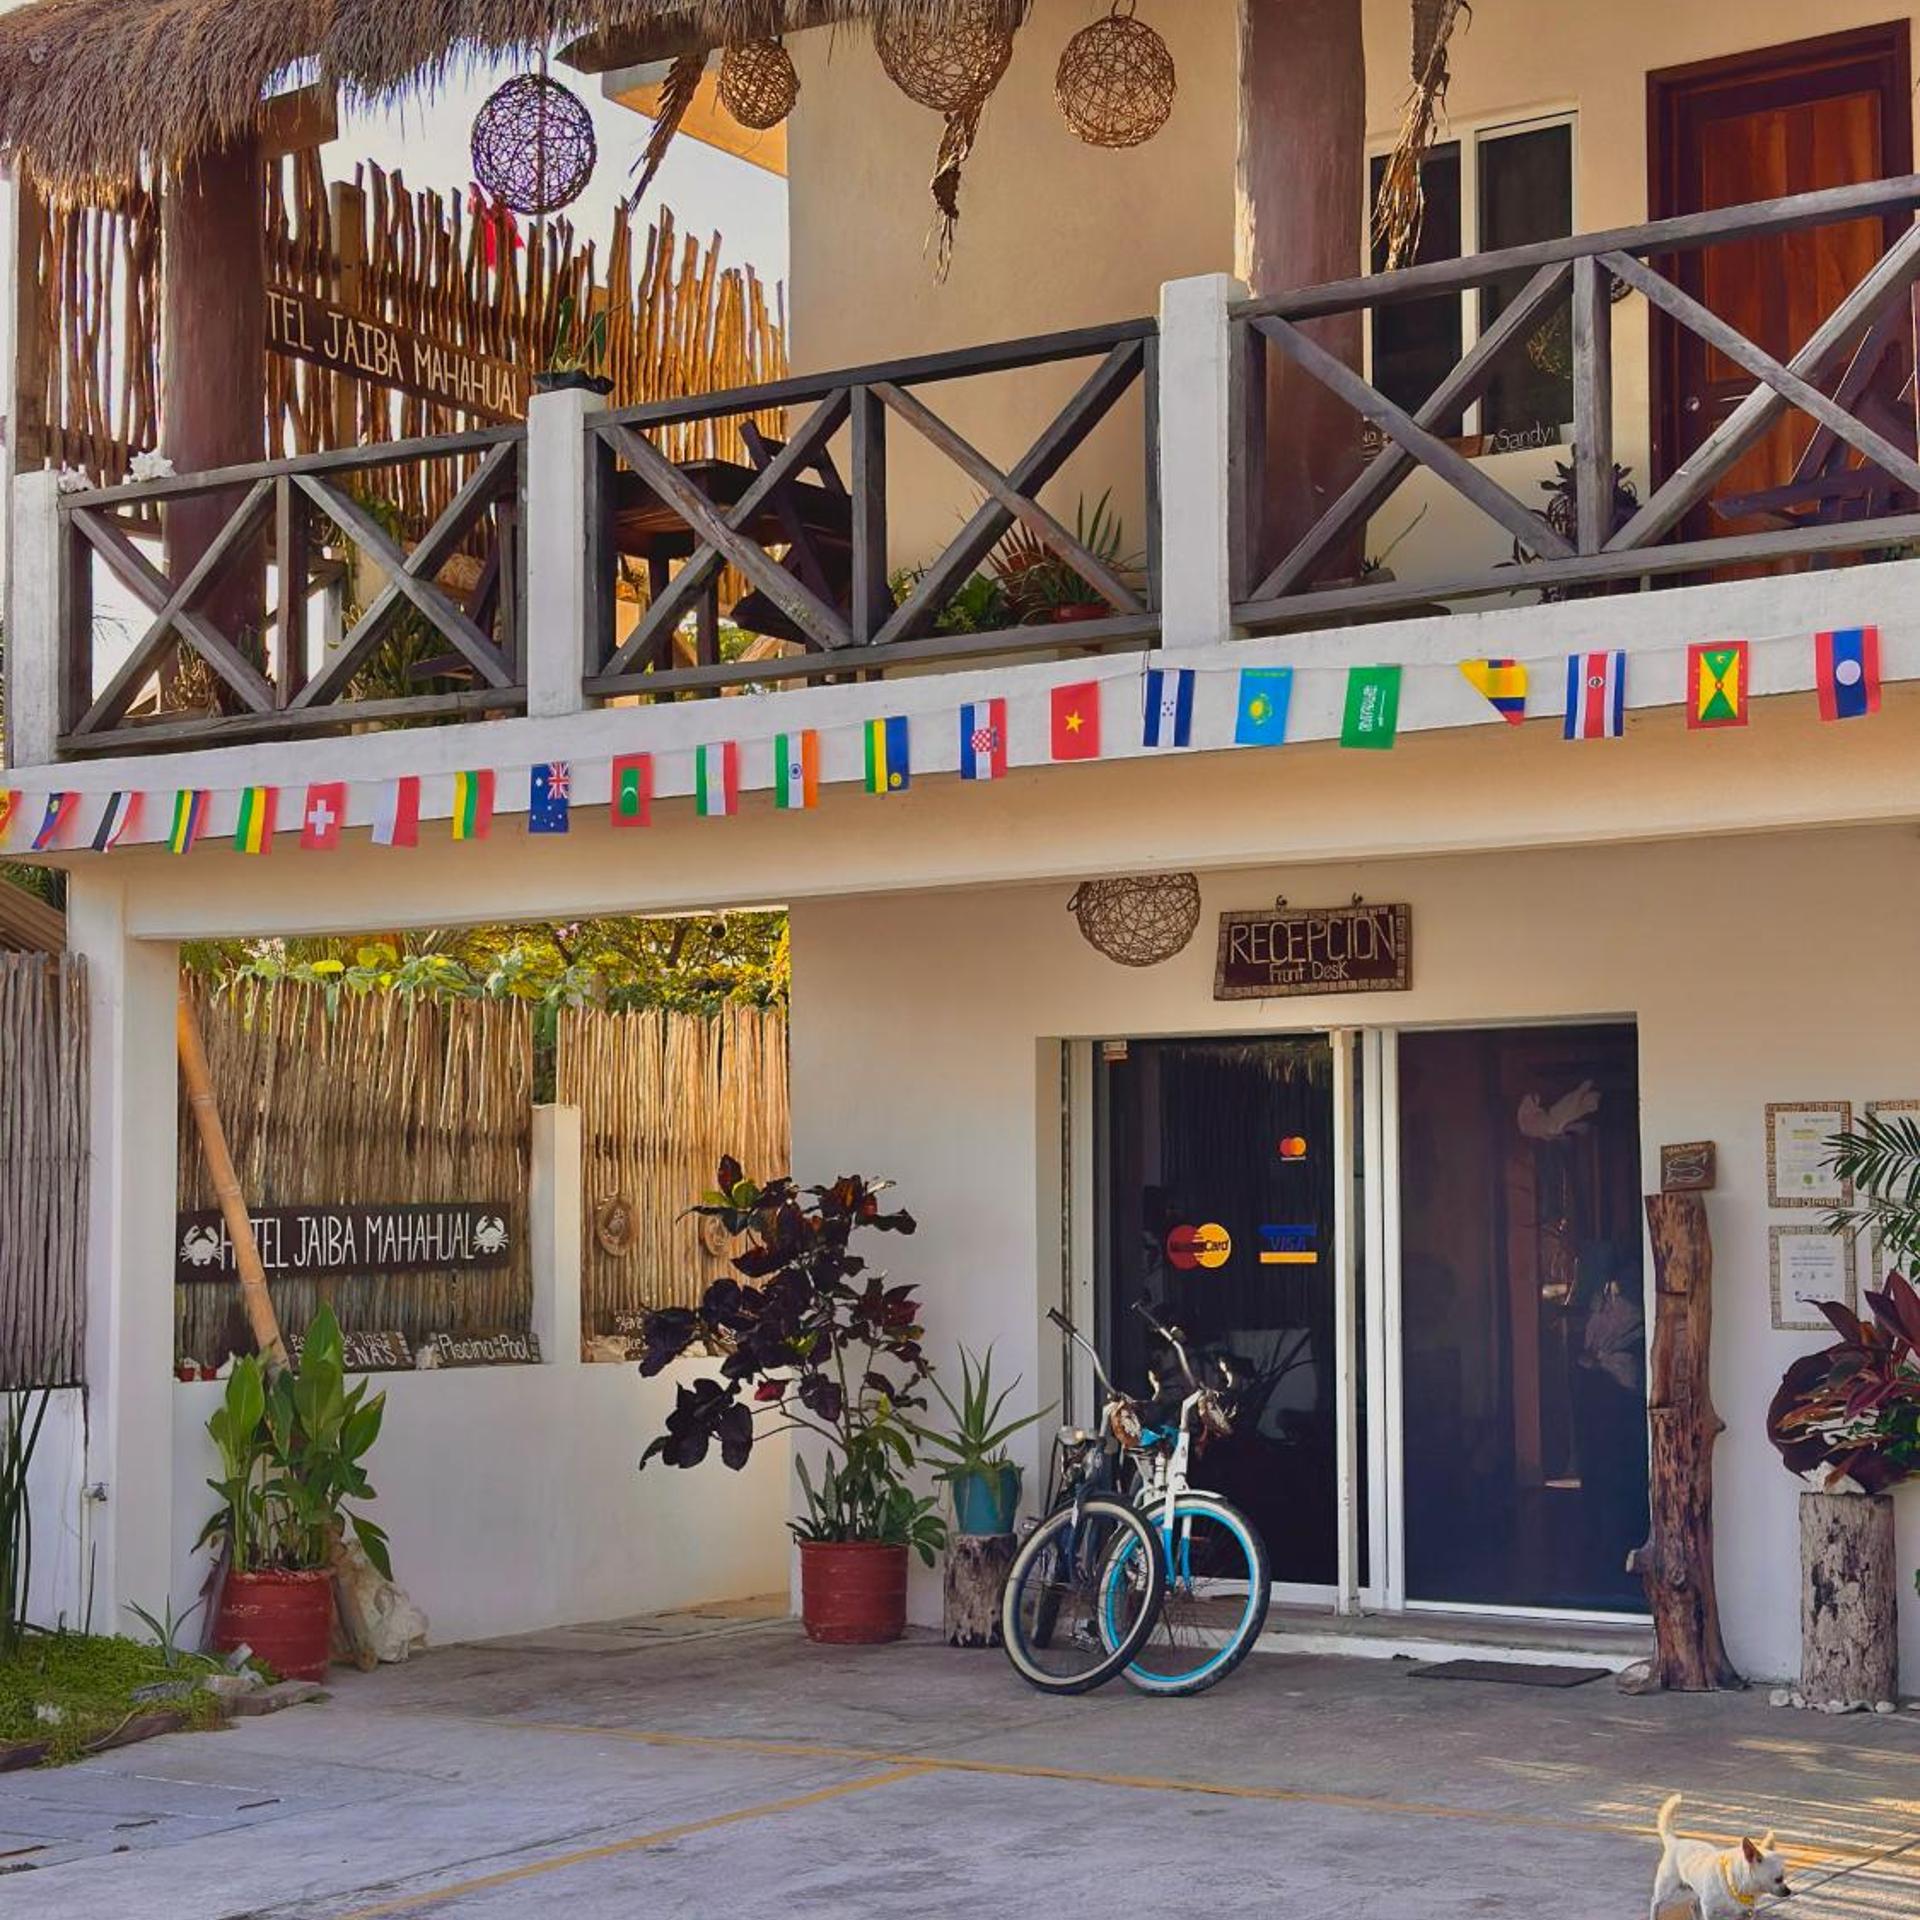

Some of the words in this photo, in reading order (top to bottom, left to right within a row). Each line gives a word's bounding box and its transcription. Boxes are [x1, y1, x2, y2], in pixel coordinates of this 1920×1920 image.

[267, 291, 314, 352] TEL
[324, 311, 403, 382] JAIBA
[413, 340, 526, 420] MAHAHUAL
[221, 1216, 289, 1270] HTEL
[294, 1216, 358, 1267] JAIBA
[366, 1212, 475, 1264] MAHAHUAL
